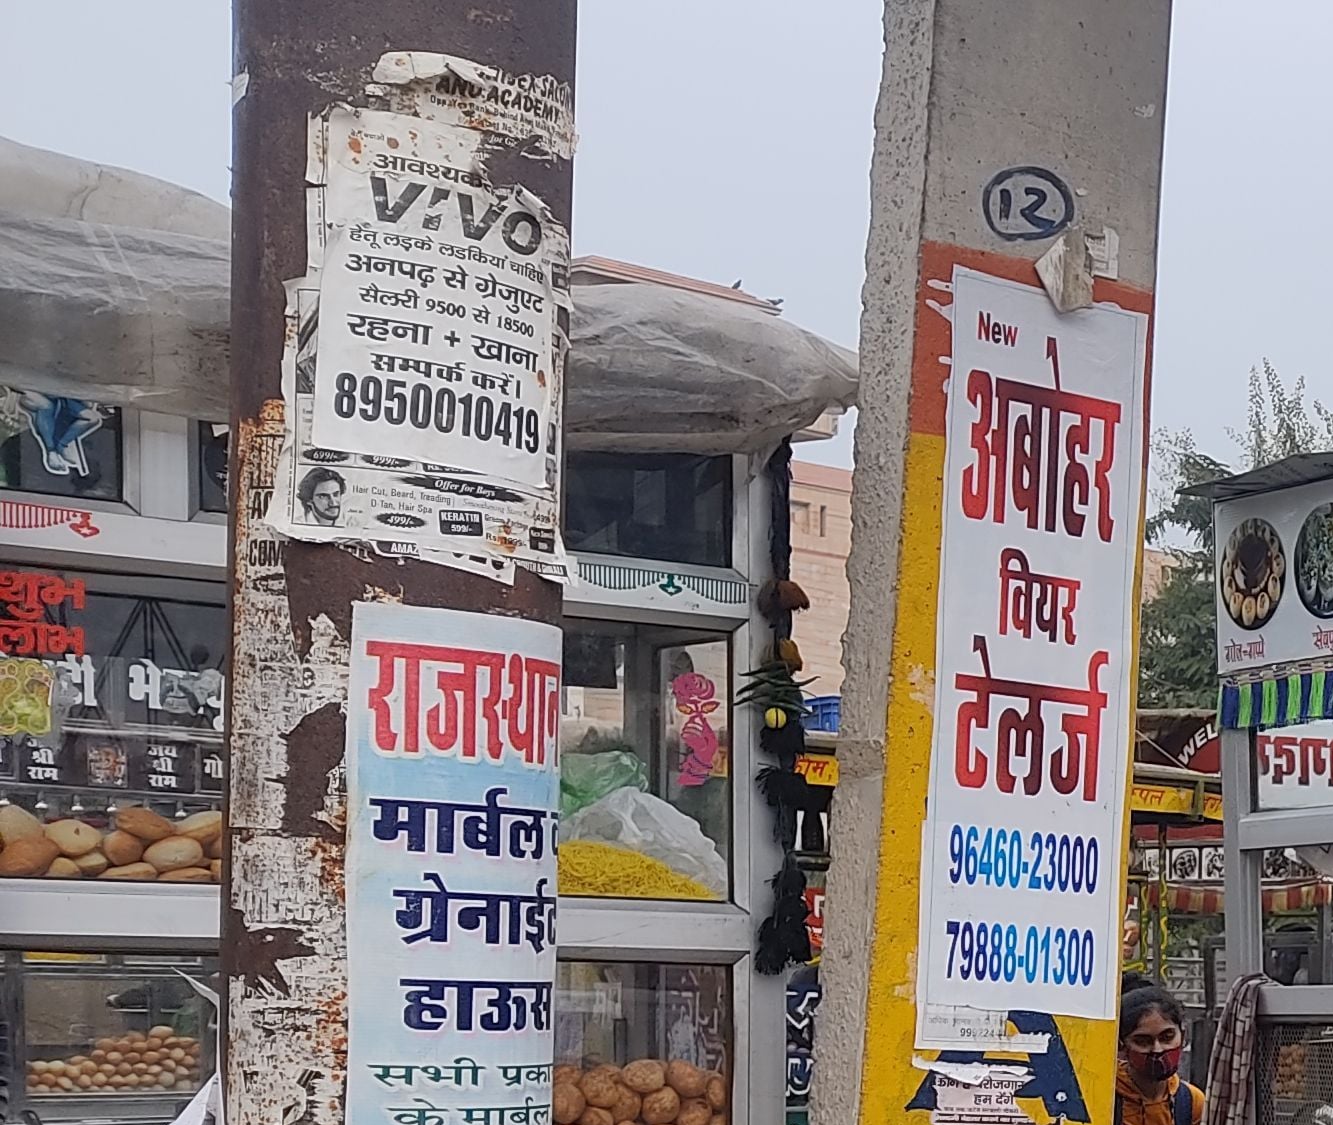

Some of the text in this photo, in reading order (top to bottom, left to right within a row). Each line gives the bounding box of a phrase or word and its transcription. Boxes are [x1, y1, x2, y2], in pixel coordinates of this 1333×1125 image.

[486, 85, 561, 124] ACADEMY
[999, 187, 1056, 230] 12
[344, 253, 545, 314] अनपढ़ से ग्रेजुएट
[358, 283, 535, 338] सैलरी 9500 से 18500
[346, 313, 434, 346] रहना
[471, 334, 539, 373] खाना
[977, 311, 1018, 348] New
[370, 352, 466, 383] सम्पर्क
[333, 372, 540, 455] 8950010419
[434, 479, 460, 492] Offer
[460, 484, 475, 494] for
[999, 547, 1081, 646] वियर
[954, 634, 1109, 802] टेलर्ज
[27, 766, 59, 781] राम
[148, 774, 178, 788] राम
[369, 788, 547, 858] मार्बल
[949, 825, 1099, 894] 96460-23000
[945, 922, 1095, 987] 79888-01300
[399, 978, 552, 1032] हाऊस
[367, 1056, 487, 1088] सभी
